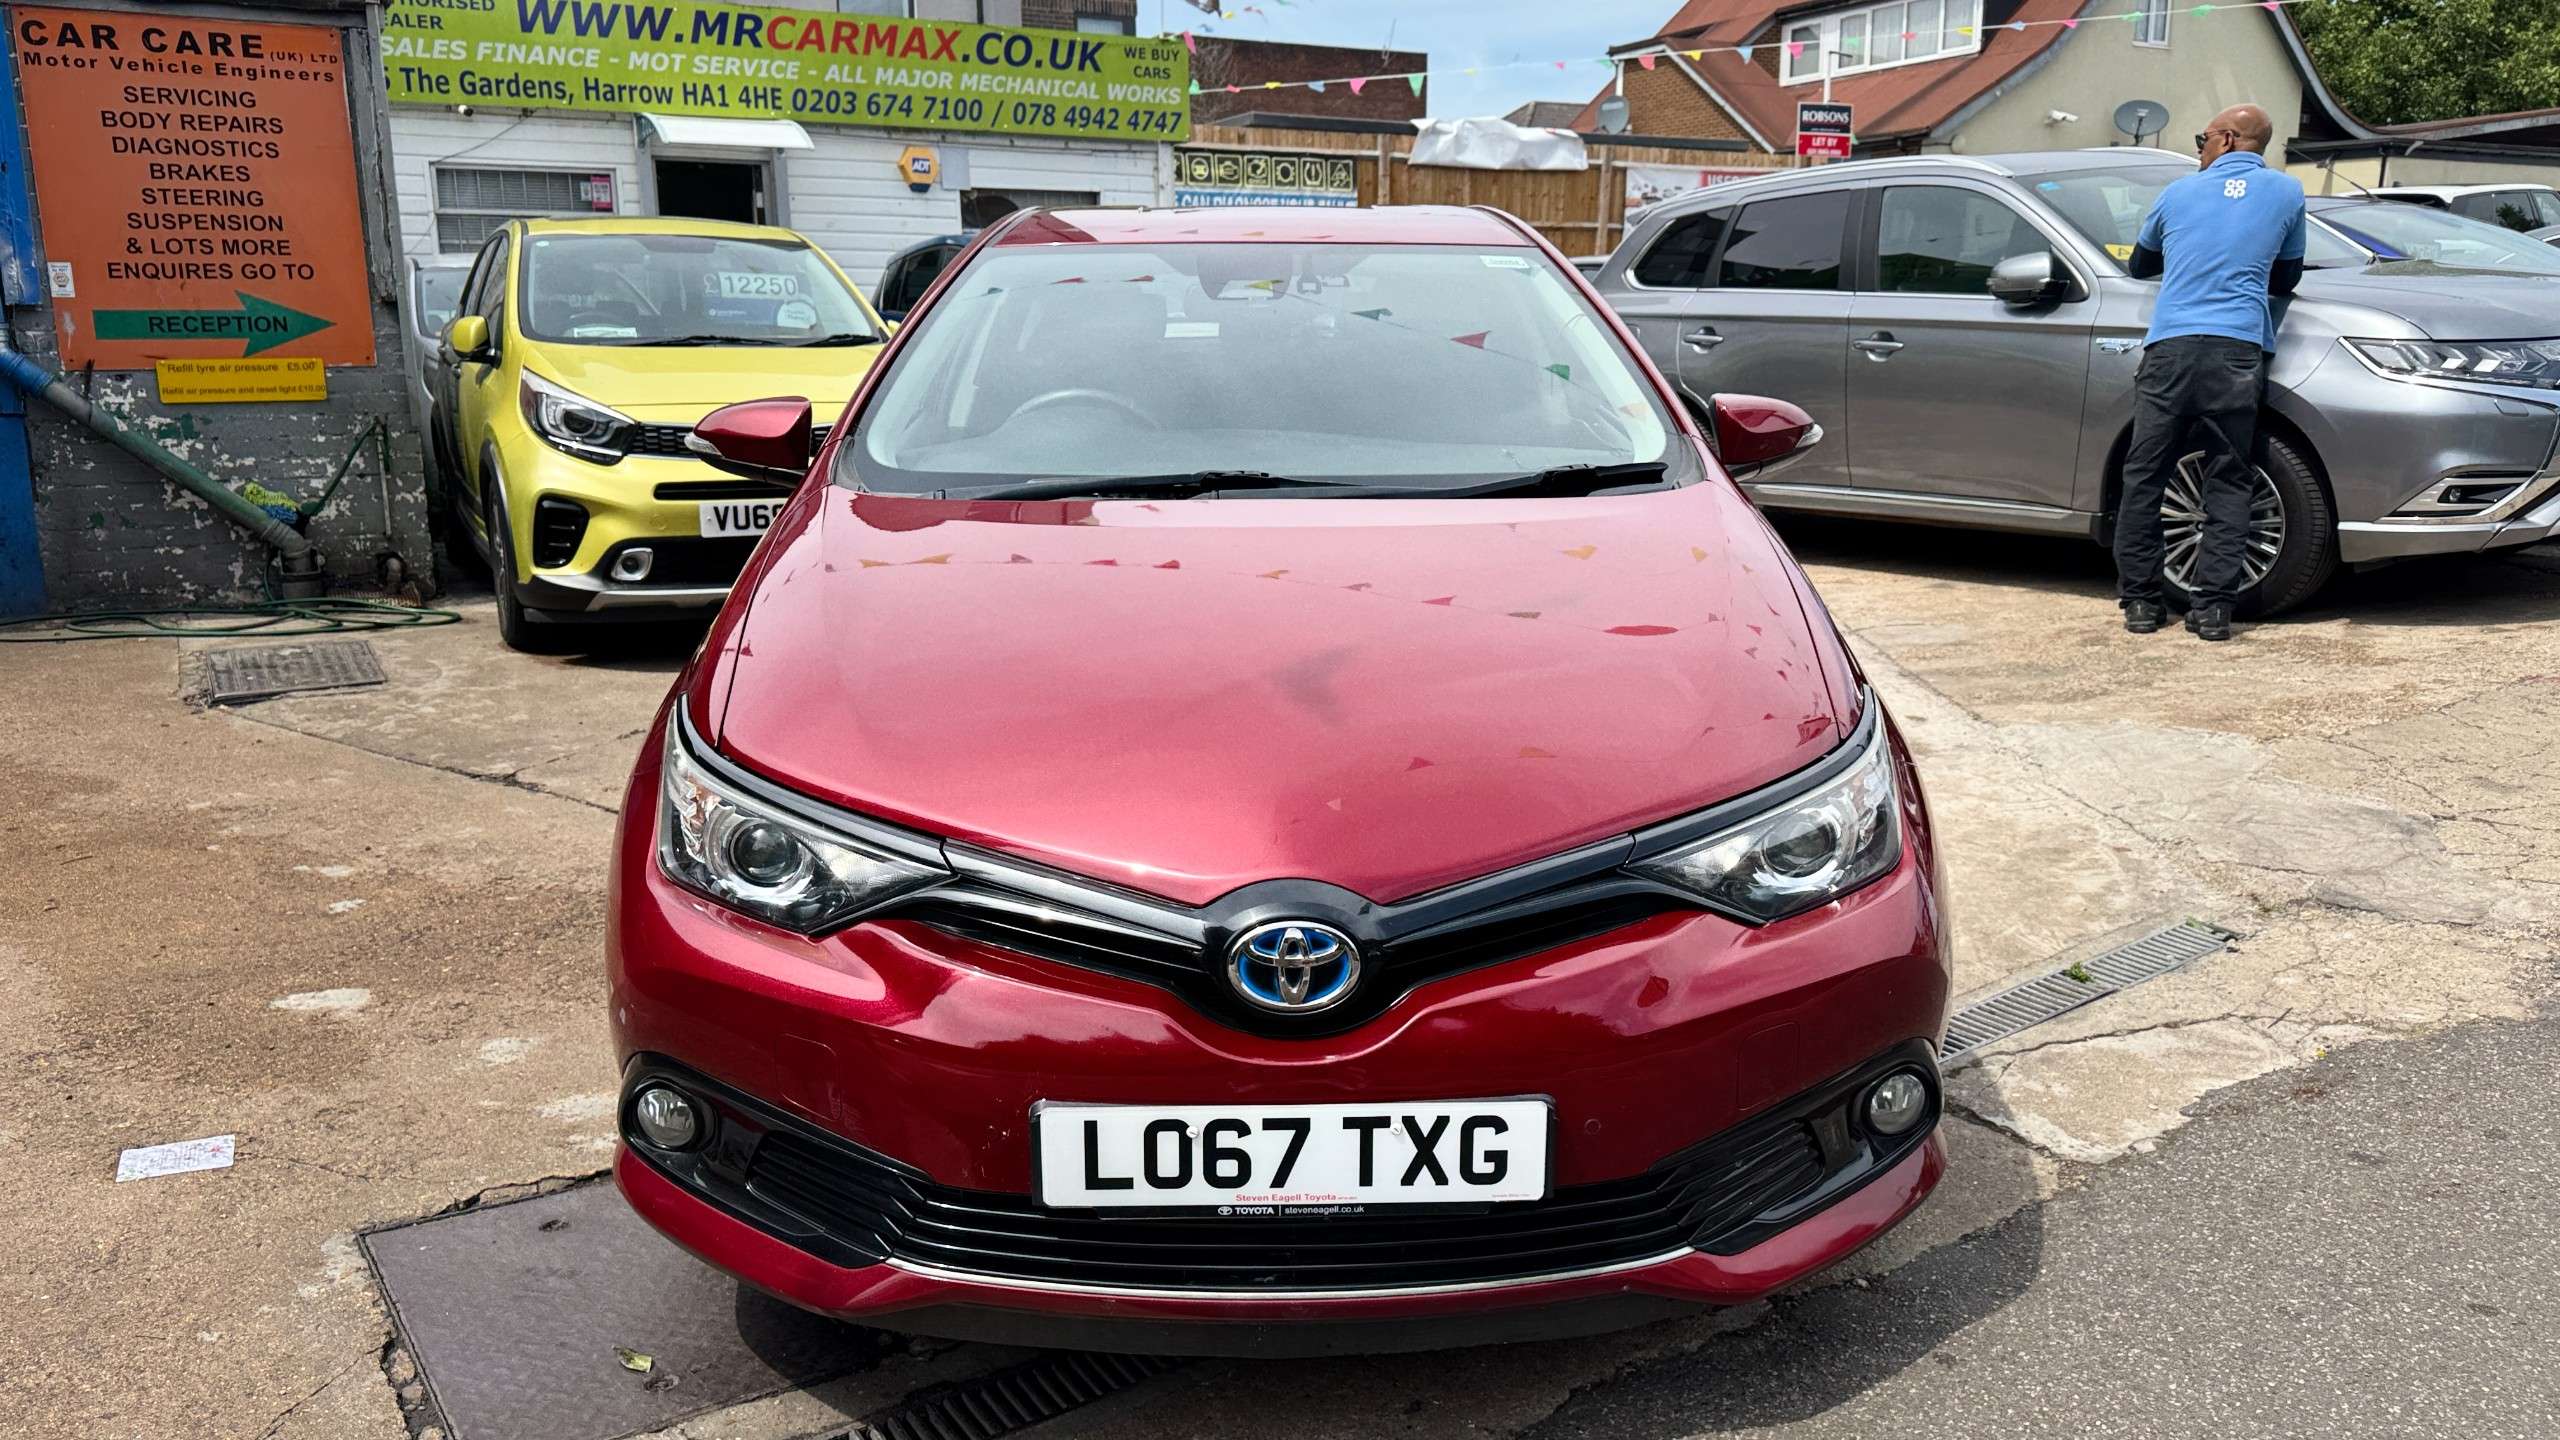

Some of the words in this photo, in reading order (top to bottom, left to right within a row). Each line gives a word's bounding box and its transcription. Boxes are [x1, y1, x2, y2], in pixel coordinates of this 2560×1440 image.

[389, 0, 495, 11] ORISED
[385, 13, 444, 30] ALER
[21, 20, 120, 51] CAR
[141, 27, 264, 59] CARE
[269, 51, 304, 64] (UK)
[310, 54, 338, 64] LTD
[517, 0, 1105, 73] WWW.MRCARMAX.CO.UK
[1124, 47, 1146, 60] WE
[1151, 48, 1180, 62] BUY
[24, 52, 98, 69] Motor
[109, 56, 203, 75] Vehicle
[216, 62, 335, 82] Engineers
[380, 36, 467, 61] SALES
[476, 41, 600, 68] FINANCE
[628, 51, 686, 73] MOT
[692, 55, 800, 80] SERVICE
[824, 64, 867, 84] ALL
[875, 67, 953, 89] MAJOR
[960, 73, 1100, 99] MECHANICAL
[1107, 83, 1182, 104] WORKS
[1133, 65, 1171, 79] CARS
[123, 86, 257, 108] SERVICING
[399, 67, 450, 94] The
[459, 70, 574, 105] Gardens,
[584, 77, 673, 104] Harrow
[683, 82, 729, 107] HA1
[738, 86, 782, 110] 4HE
[792, 88, 857, 114] 0203
[867, 93, 912, 118] 674
[923, 96, 983, 122] 7100
[1013, 102, 1056, 126] 078
[1064, 105, 1120, 130] 4942
[1127, 109, 1182, 133] 4747
[101, 110, 172, 130] BODY
[180, 113, 283, 134] REPAIRS
[1802, 110, 1849, 124] ROBSONS
[112, 136, 279, 159] DIAGNOSTICS
[149, 163, 250, 182] BRAKES
[912, 159, 930, 172] ADT
[142, 188, 264, 208] STEERING
[127, 212, 283, 232] SUSPENSION
[126, 238, 142, 254] &
[150, 238, 213, 255] LOTS
[222, 239, 291, 257] MORE
[107, 262, 233, 281] ENQUIRES
[241, 263, 276, 281] GO
[283, 264, 314, 280] TO
[148, 315, 288, 333] RECEPTION
[235, 363, 279, 374] pressure
[1083, 1117, 1312, 1191] LO67
[1342, 1114, 1509, 1187] TXG
[1236, 1193, 1269, 1202] Steven
[1272, 1193, 1302, 1203] Eagell
[1304, 1193, 1336, 1203] Toyota
[1235, 1207, 1275, 1215] TOYOTA
[1285, 1205, 1364, 1216] steveneagell.co.uk
